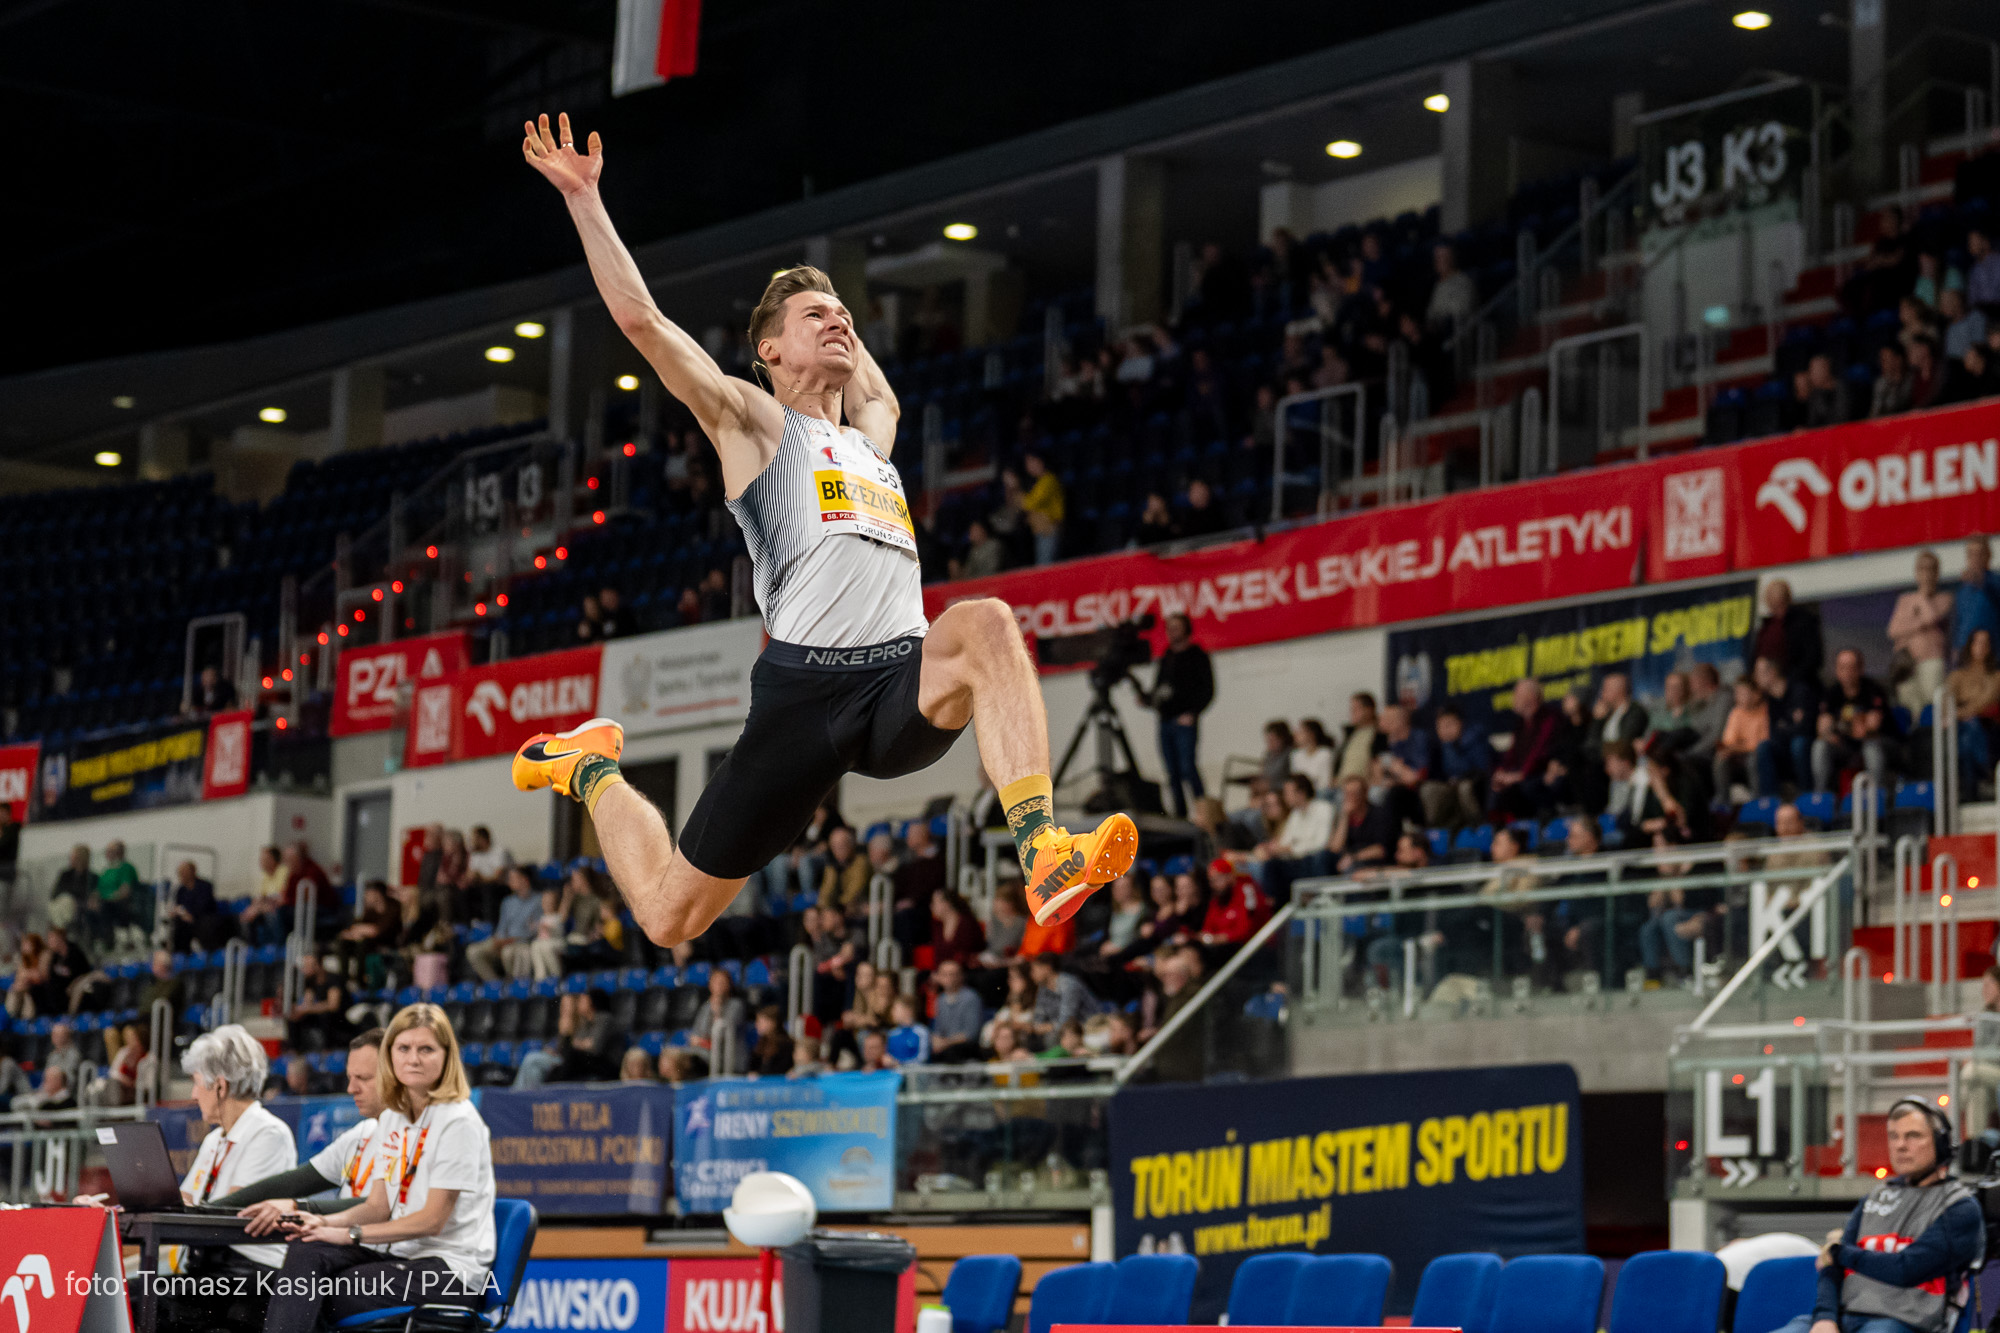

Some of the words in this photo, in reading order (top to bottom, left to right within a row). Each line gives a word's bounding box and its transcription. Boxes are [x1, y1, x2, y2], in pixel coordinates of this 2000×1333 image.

[1651, 141, 1705, 206] J3
[1722, 122, 1786, 190] K3
[1839, 439, 1998, 512] ORLEN
[1449, 505, 1632, 572] ATLETYKI
[805, 649, 867, 666] NIKE
[867, 640, 913, 664] PRO
[510, 674, 594, 723] ORLEN
[1749, 877, 1827, 961] K1
[1705, 1067, 1775, 1156] L1
[1131, 1128, 1244, 1220] TORUŃ
[1246, 1122, 1411, 1207] MIASTEM
[1414, 1102, 1568, 1187] SPORTU
[1193, 1203, 1332, 1255] www.torun.pl
